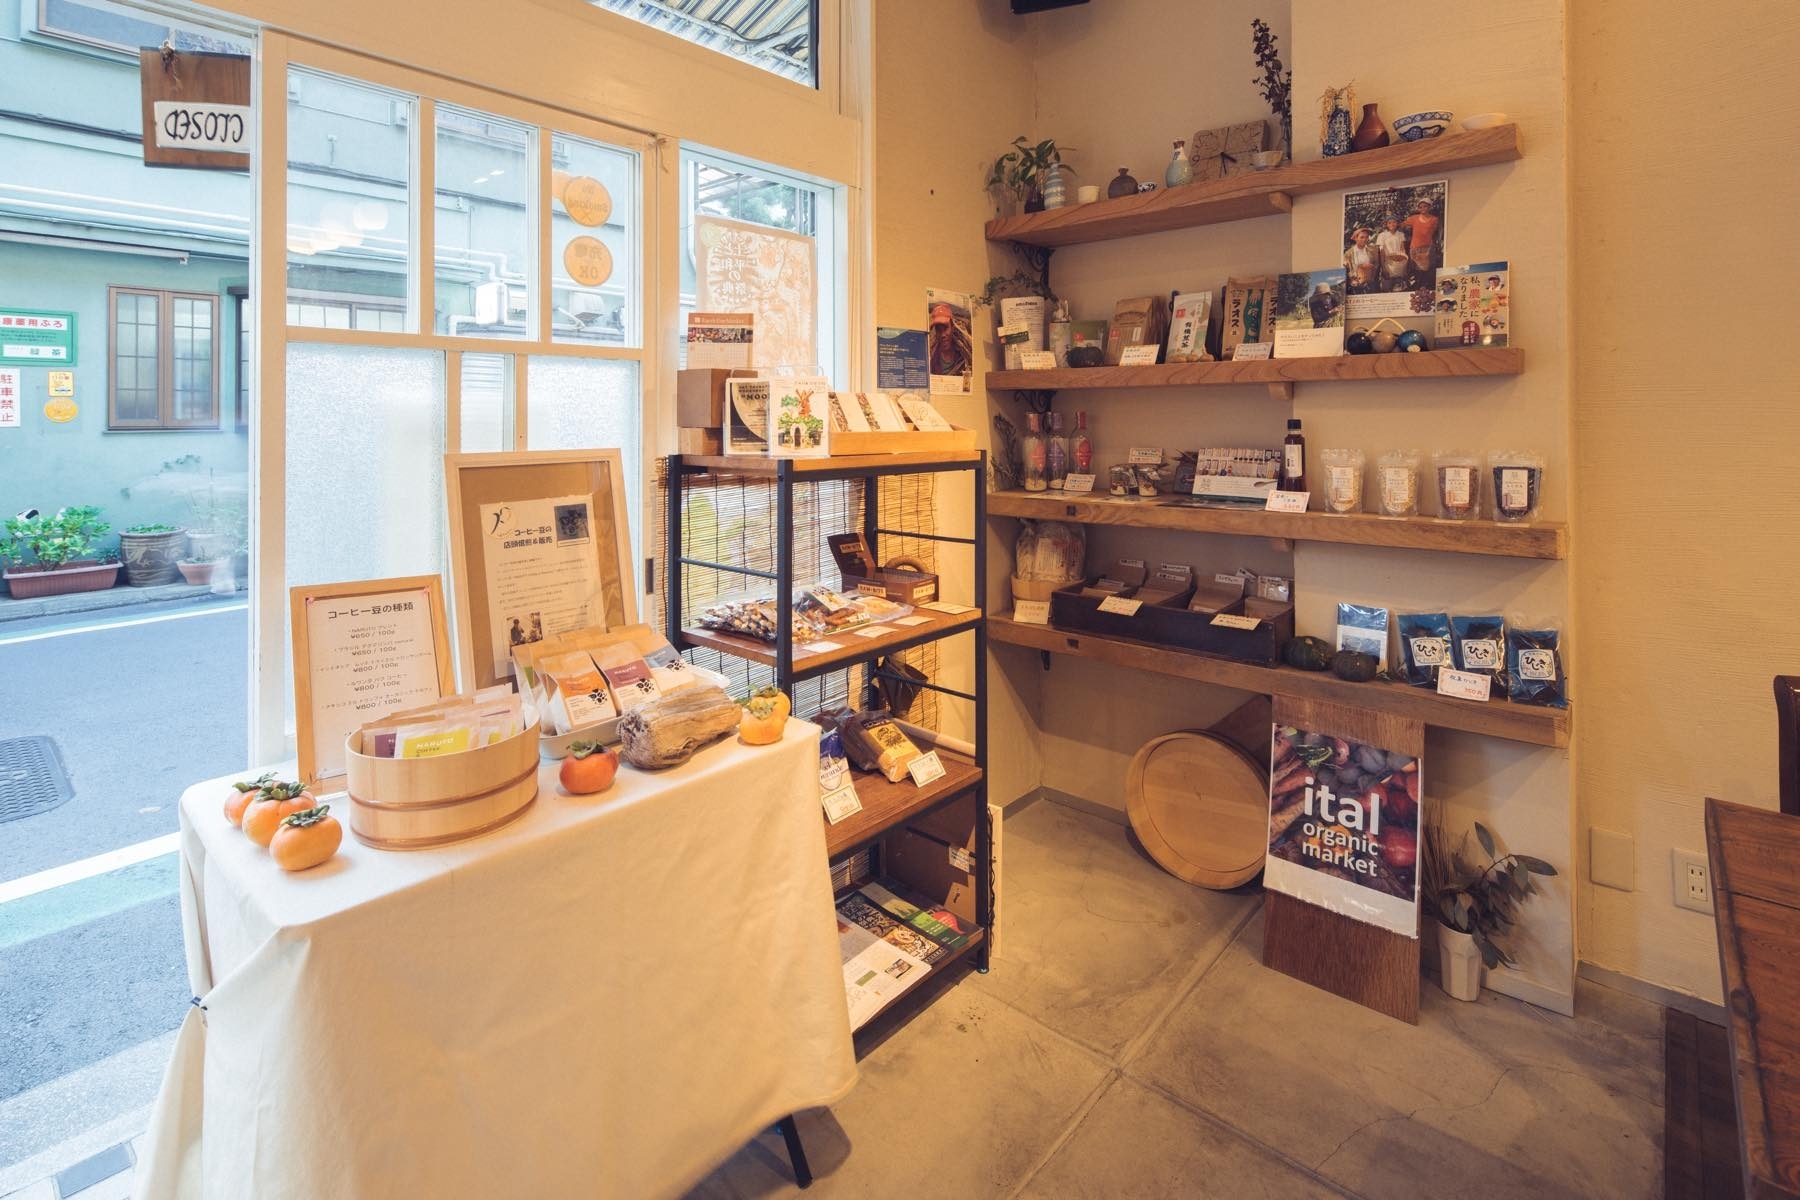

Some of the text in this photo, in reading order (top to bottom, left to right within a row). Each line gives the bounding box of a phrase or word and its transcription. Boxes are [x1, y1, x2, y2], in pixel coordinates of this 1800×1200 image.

[514, 525, 552, 537] コーヒー豆の
[327, 601, 415, 620] コーヒー豆の種類
[1416, 643, 1438, 657] ひじき
[1467, 645, 1489, 659] ひじき
[1525, 655, 1546, 671] ひじき
[1303, 776, 1380, 835] ital
[1302, 822, 1379, 856] organic
[1302, 841, 1378, 877] market
